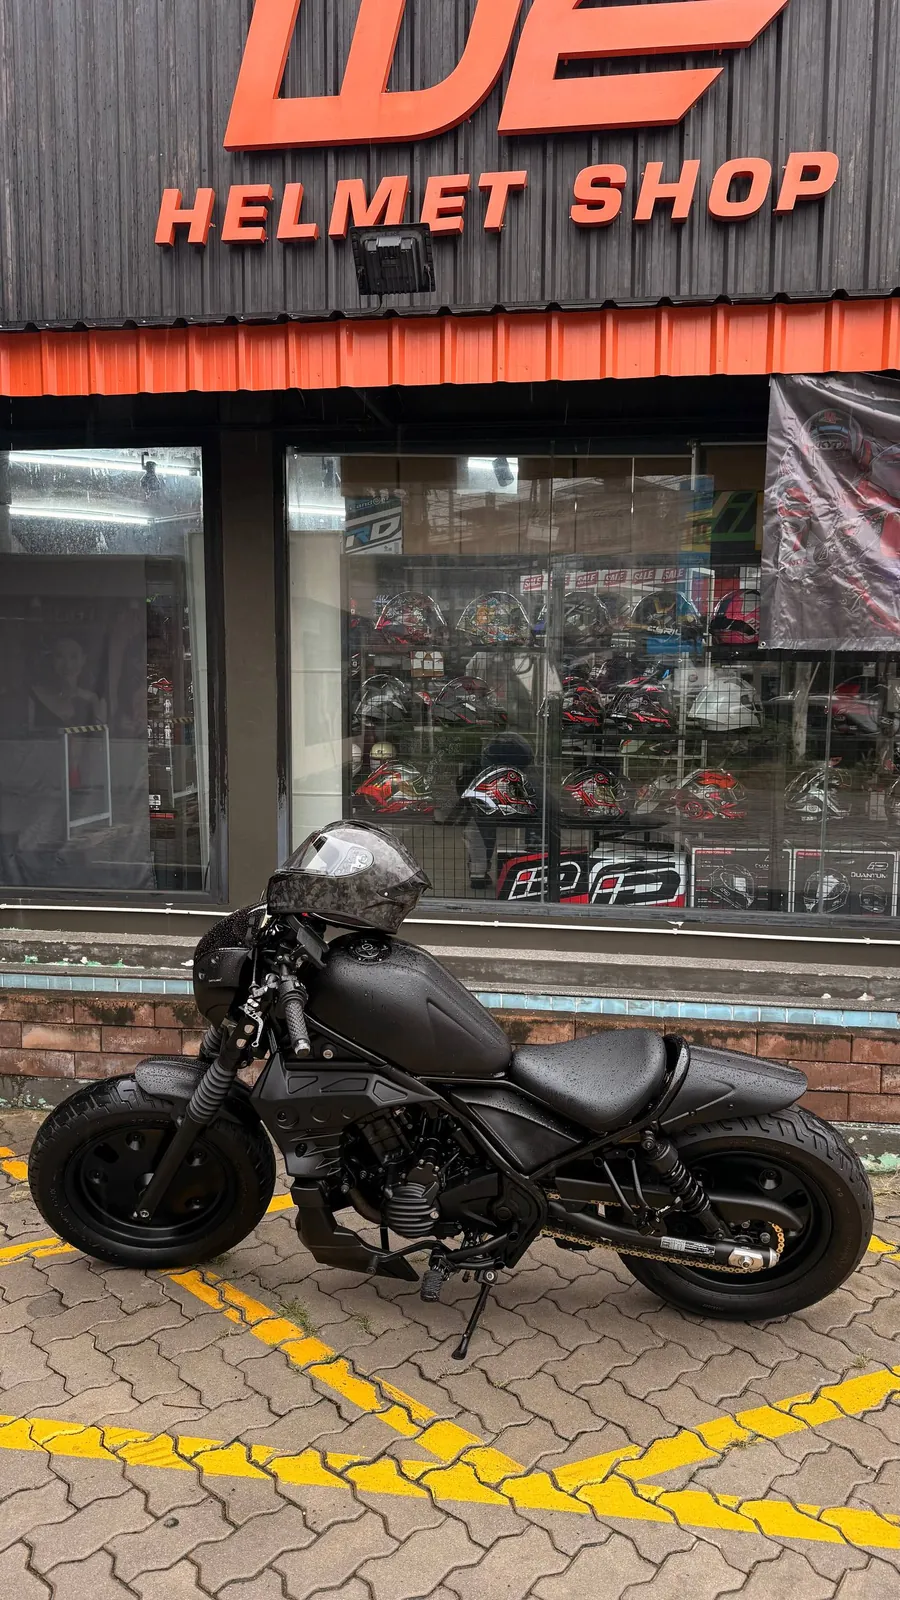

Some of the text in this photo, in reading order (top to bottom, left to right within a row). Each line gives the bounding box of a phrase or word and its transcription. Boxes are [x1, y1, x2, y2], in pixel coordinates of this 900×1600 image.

[154, 151, 839, 246] HELMET SHOP
[605, 571, 626, 583] SALE
[633, 569, 654, 581] SALE
[662, 568, 685, 580] SALE
